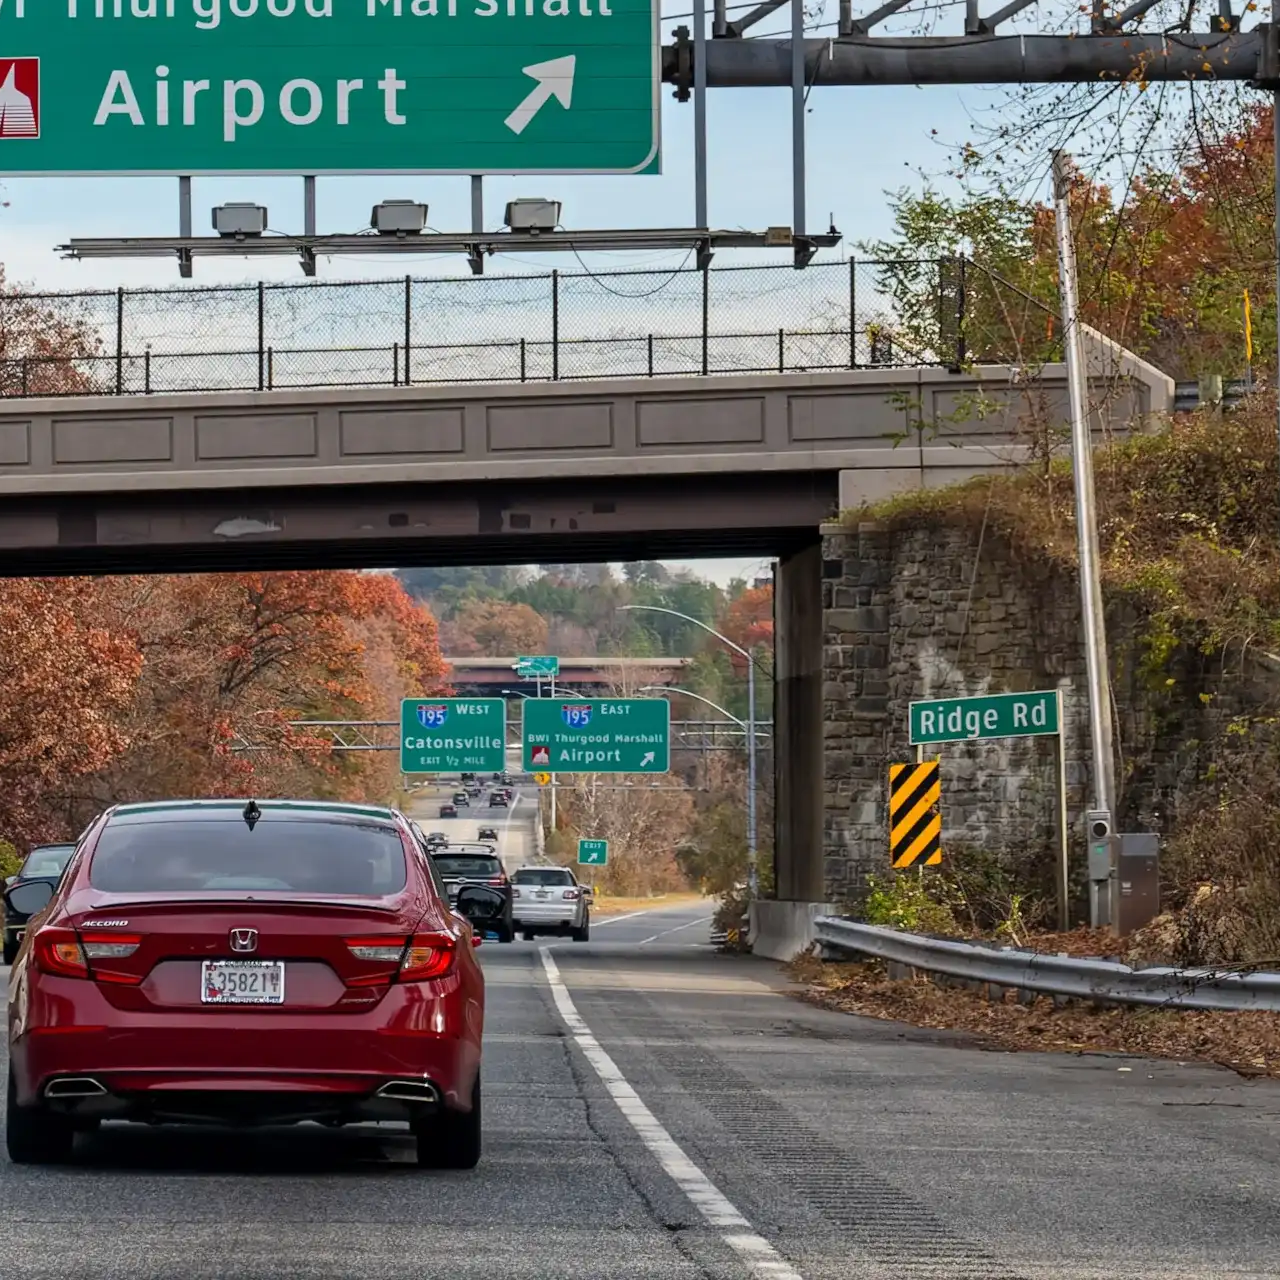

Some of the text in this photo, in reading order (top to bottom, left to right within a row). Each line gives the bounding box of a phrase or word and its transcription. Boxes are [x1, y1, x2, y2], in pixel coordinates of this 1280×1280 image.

[93, 64, 407, 142] Airport
[455, 703, 490, 715] WEST
[600, 703, 631, 715] EAST
[421, 710, 445, 725] 195
[566, 710, 589, 725] 195
[920, 699, 1047, 738] Ridge Rd
[404, 736, 502, 750] Catonsville
[527, 734, 664, 746] BWI Thurgood Marshall
[420, 756, 441, 765] EXIT
[464, 756, 486, 765] MILE
[559, 748, 621, 764] Airport
[218, 971, 267, 993] 35821
